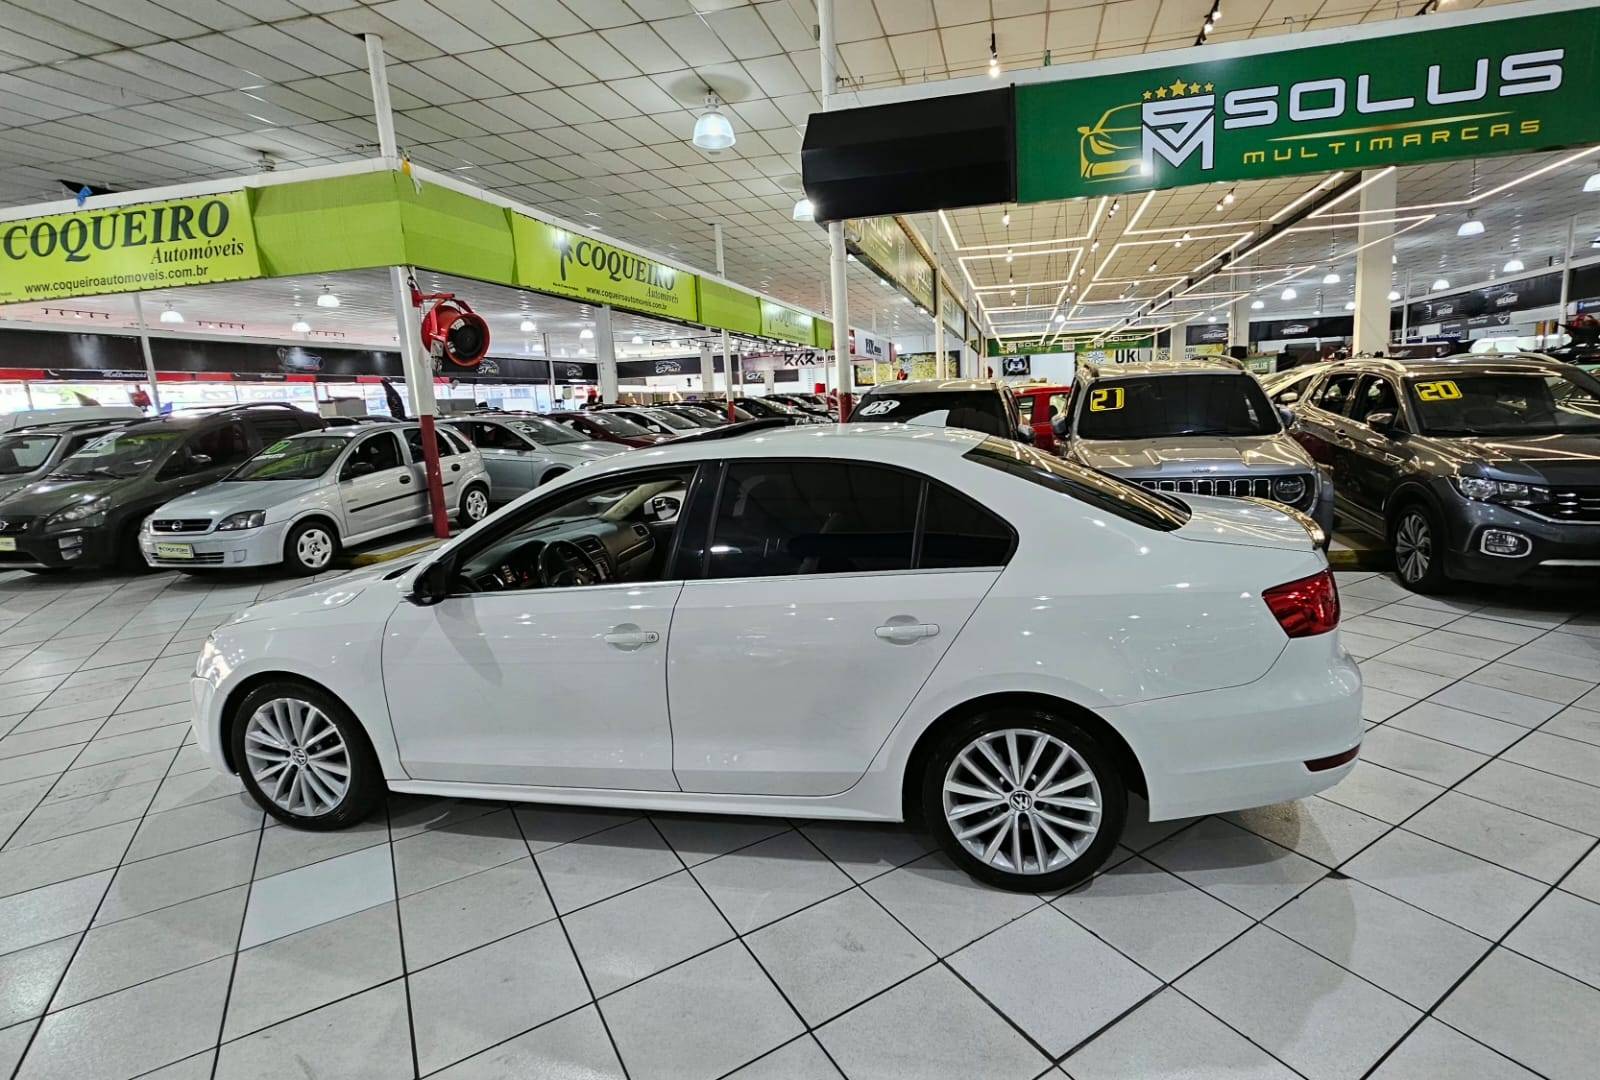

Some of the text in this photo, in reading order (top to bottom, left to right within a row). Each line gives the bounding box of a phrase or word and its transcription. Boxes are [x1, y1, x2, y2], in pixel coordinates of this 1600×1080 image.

[1223, 48, 1565, 130] SOLUS
[1242, 120, 1541, 164] MULTIMARCAS
[3, 200, 230, 262] COQUEIRO
[150, 237, 245, 265] Automóveis
[25, 264, 209, 293] www.coqueiroautomoveis.com.br
[1091, 388, 1123, 410] 21
[1417, 381, 1460, 400] 20
[861, 400, 899, 415] 23
